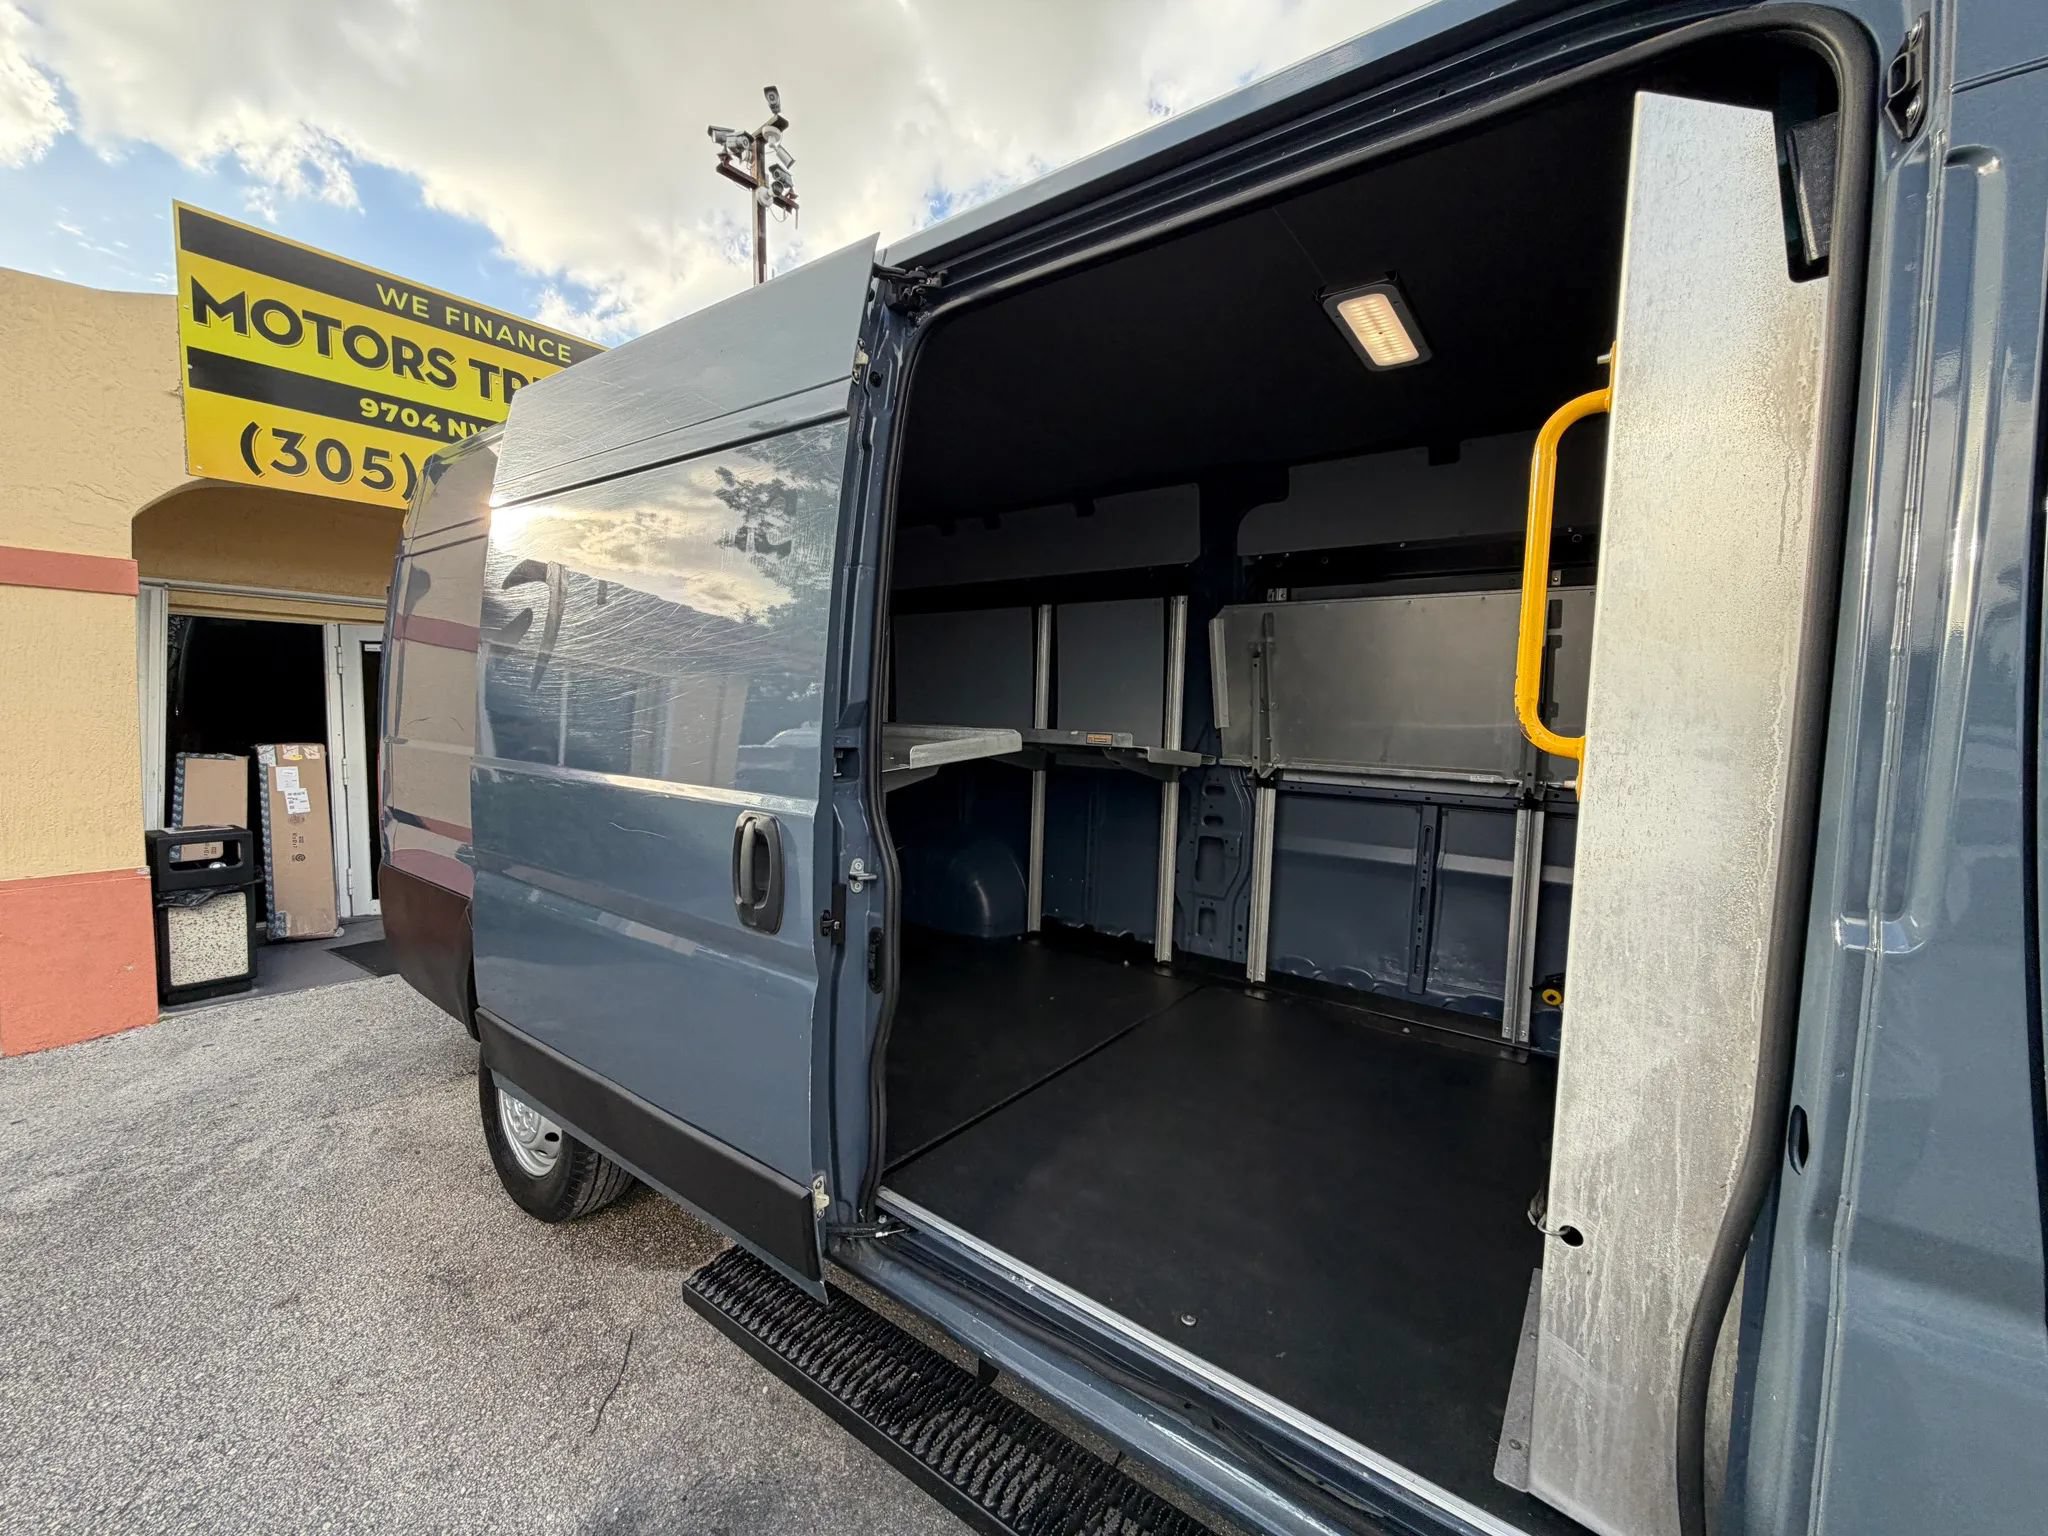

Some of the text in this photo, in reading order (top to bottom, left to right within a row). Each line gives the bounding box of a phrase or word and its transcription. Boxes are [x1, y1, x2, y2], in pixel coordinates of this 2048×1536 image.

[190, 275, 541, 405] MOTORS TR
[376, 283, 572, 363] WE FINANCE
[359, 397, 441, 433] 9704
[240, 421, 418, 500] (305)
